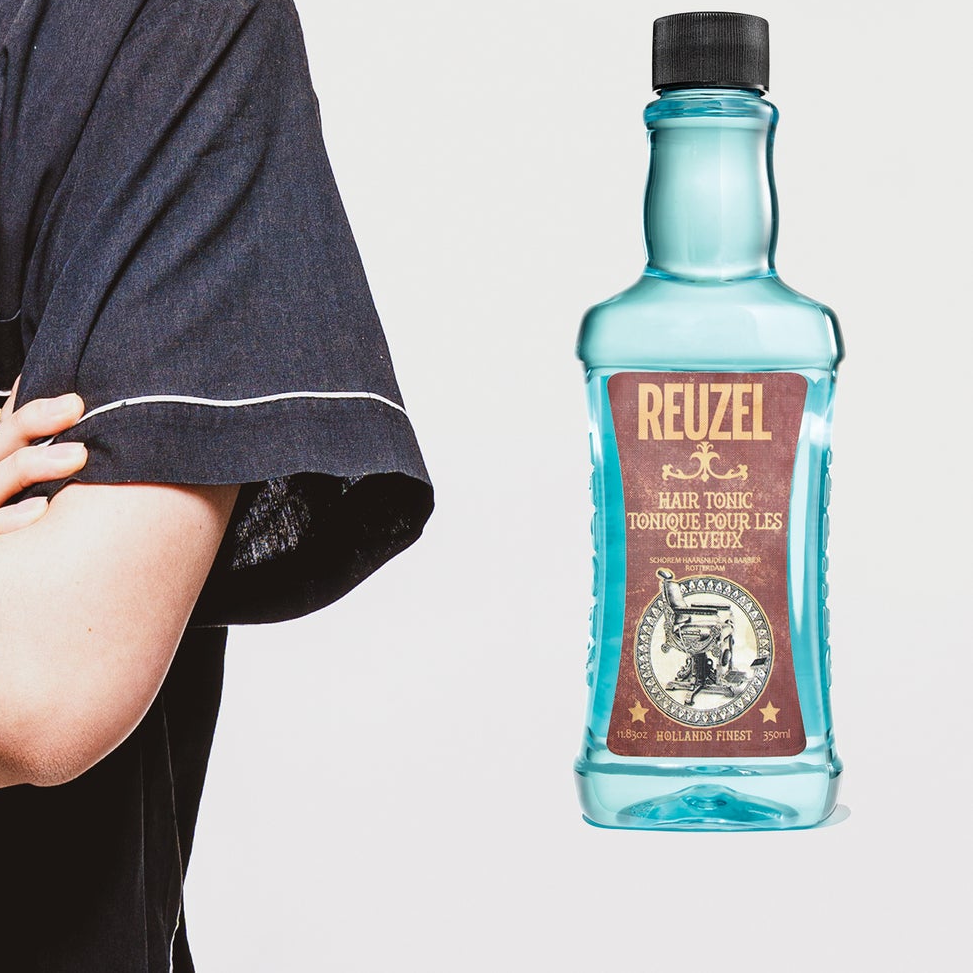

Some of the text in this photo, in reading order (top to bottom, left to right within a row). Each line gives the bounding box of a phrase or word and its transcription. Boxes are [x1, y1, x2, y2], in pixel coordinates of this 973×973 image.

[638, 383, 772, 441] REUZEL
[658, 492, 753, 509] HAIR TONIC
[627, 512, 783, 532] TONIQUE POUR LES
[665, 529, 743, 549] CHEVEUX
[649, 556, 681, 564] SCHOREM
[685, 564, 726, 572] ROTTERDAM
[616, 729, 648, 741] 11.83oz
[656, 730, 753, 742] HOLLANDS FINEST
[763, 729, 791, 741] 350ml
